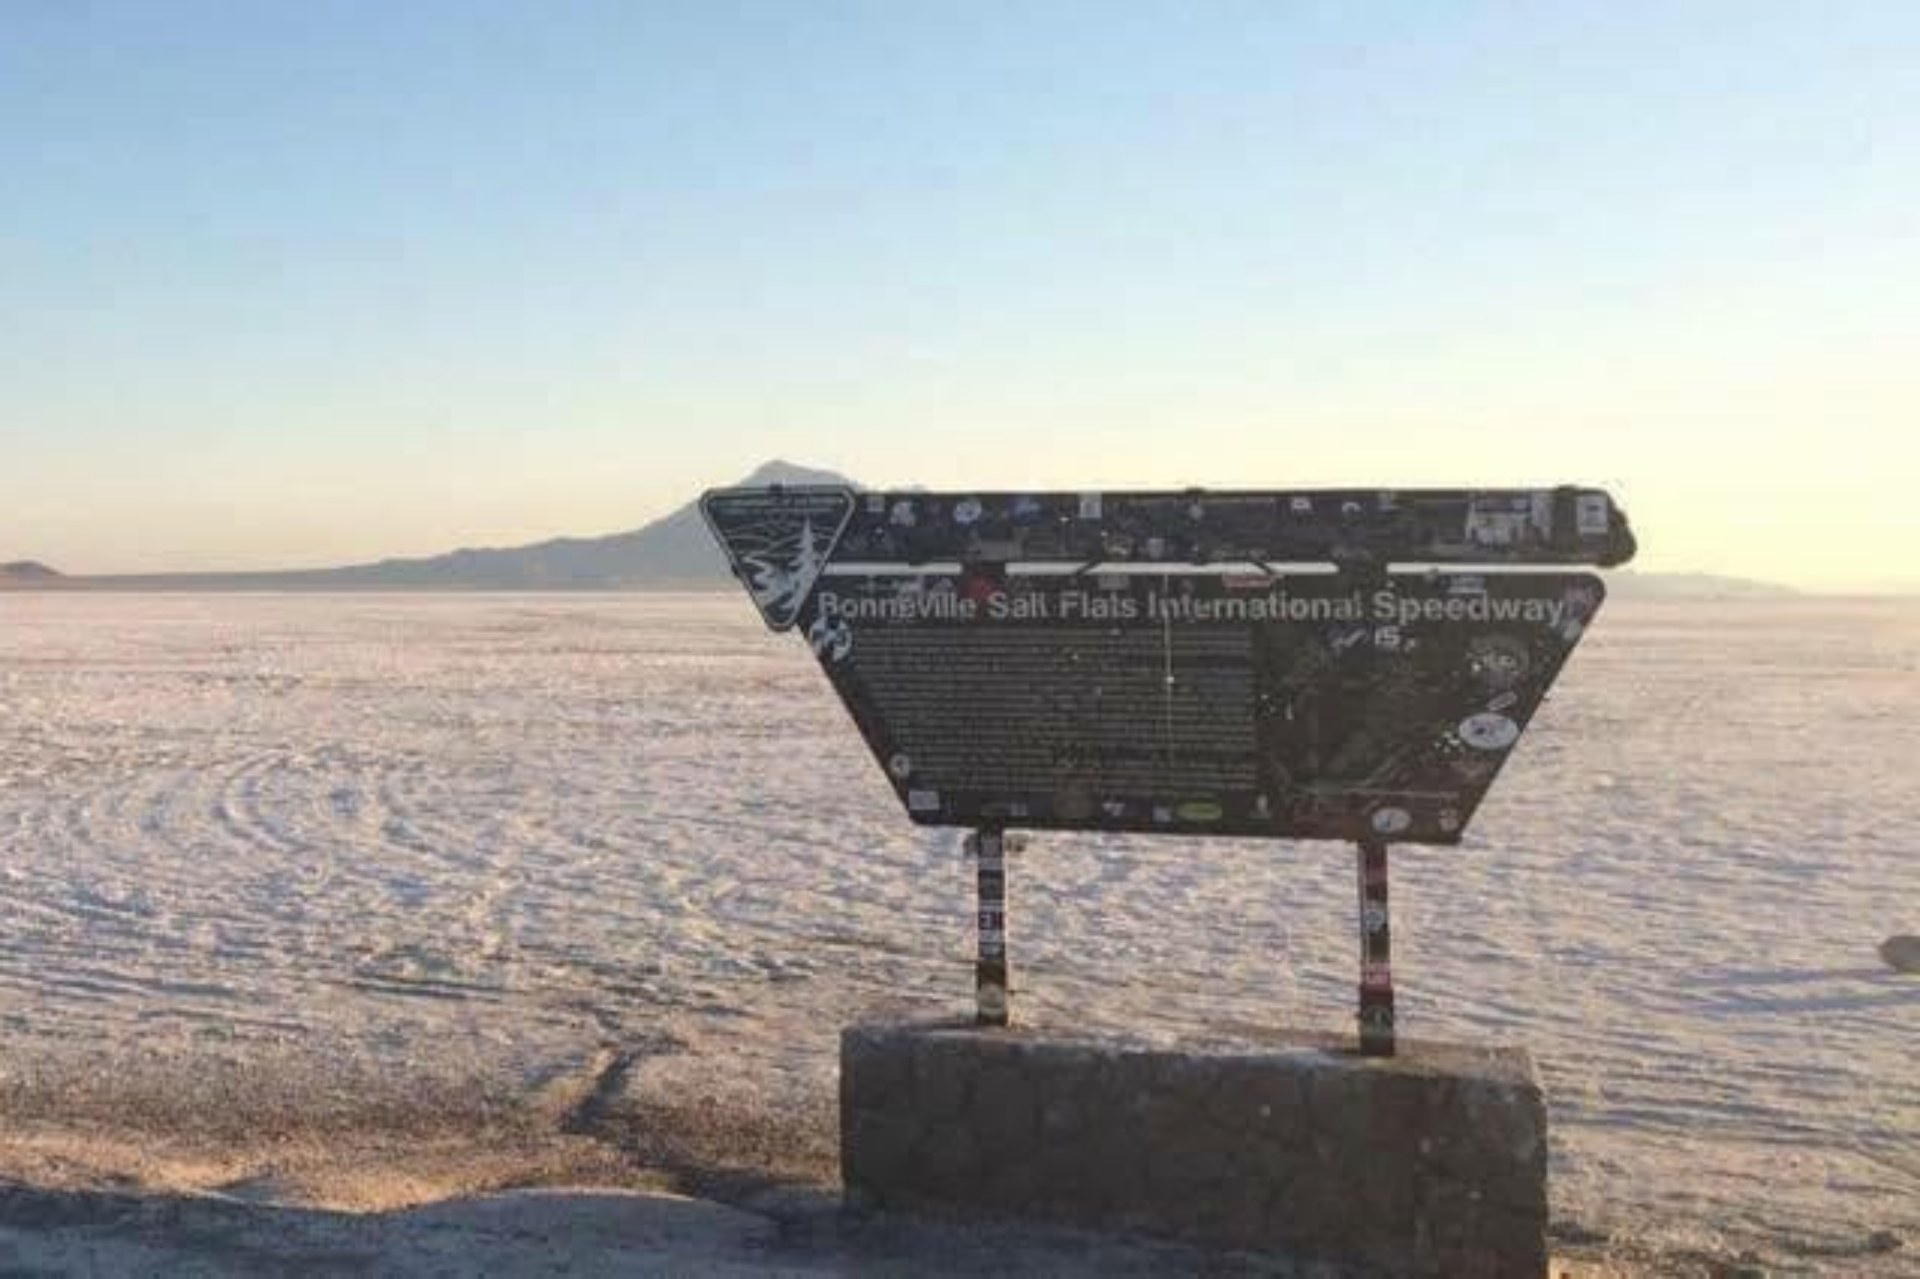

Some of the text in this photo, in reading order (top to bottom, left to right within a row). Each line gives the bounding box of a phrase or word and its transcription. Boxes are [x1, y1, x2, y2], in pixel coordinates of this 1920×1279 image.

[817, 590, 1564, 627] Bonneville Salt Flats International Speedway
